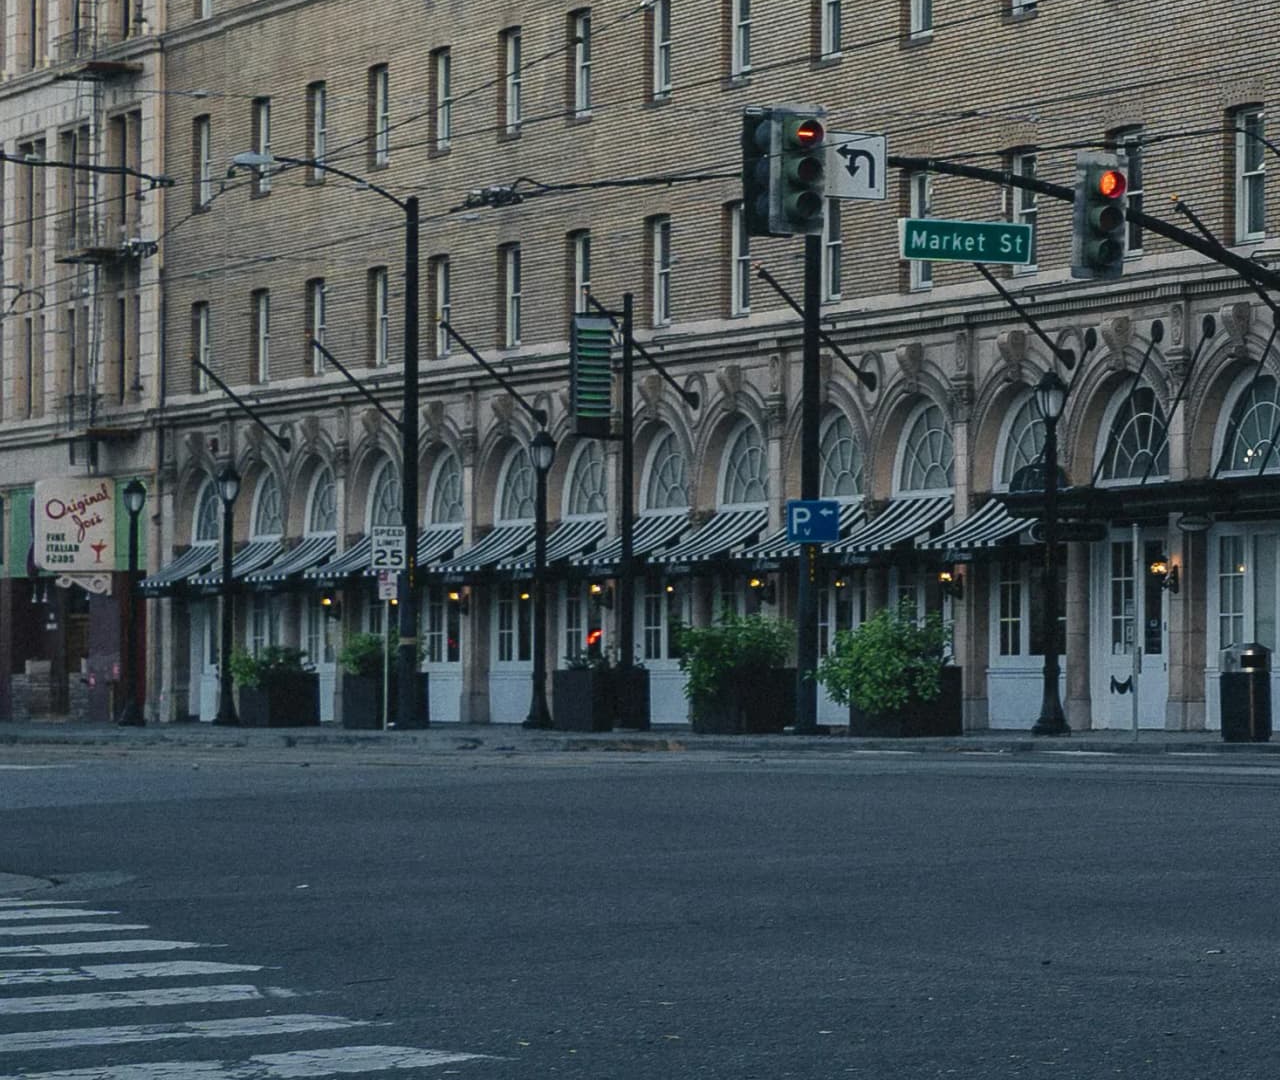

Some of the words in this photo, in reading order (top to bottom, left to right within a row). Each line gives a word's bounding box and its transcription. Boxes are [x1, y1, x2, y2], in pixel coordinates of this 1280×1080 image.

[911, 230, 986, 252] Market
[1000, 233, 1023, 254] St
[45, 483, 111, 520] Original
[374, 528, 405, 537] SPEED
[46, 544, 80, 553] ITALIAN
[377, 539, 400, 547] LIMIT
[374, 549, 404, 566] 25
